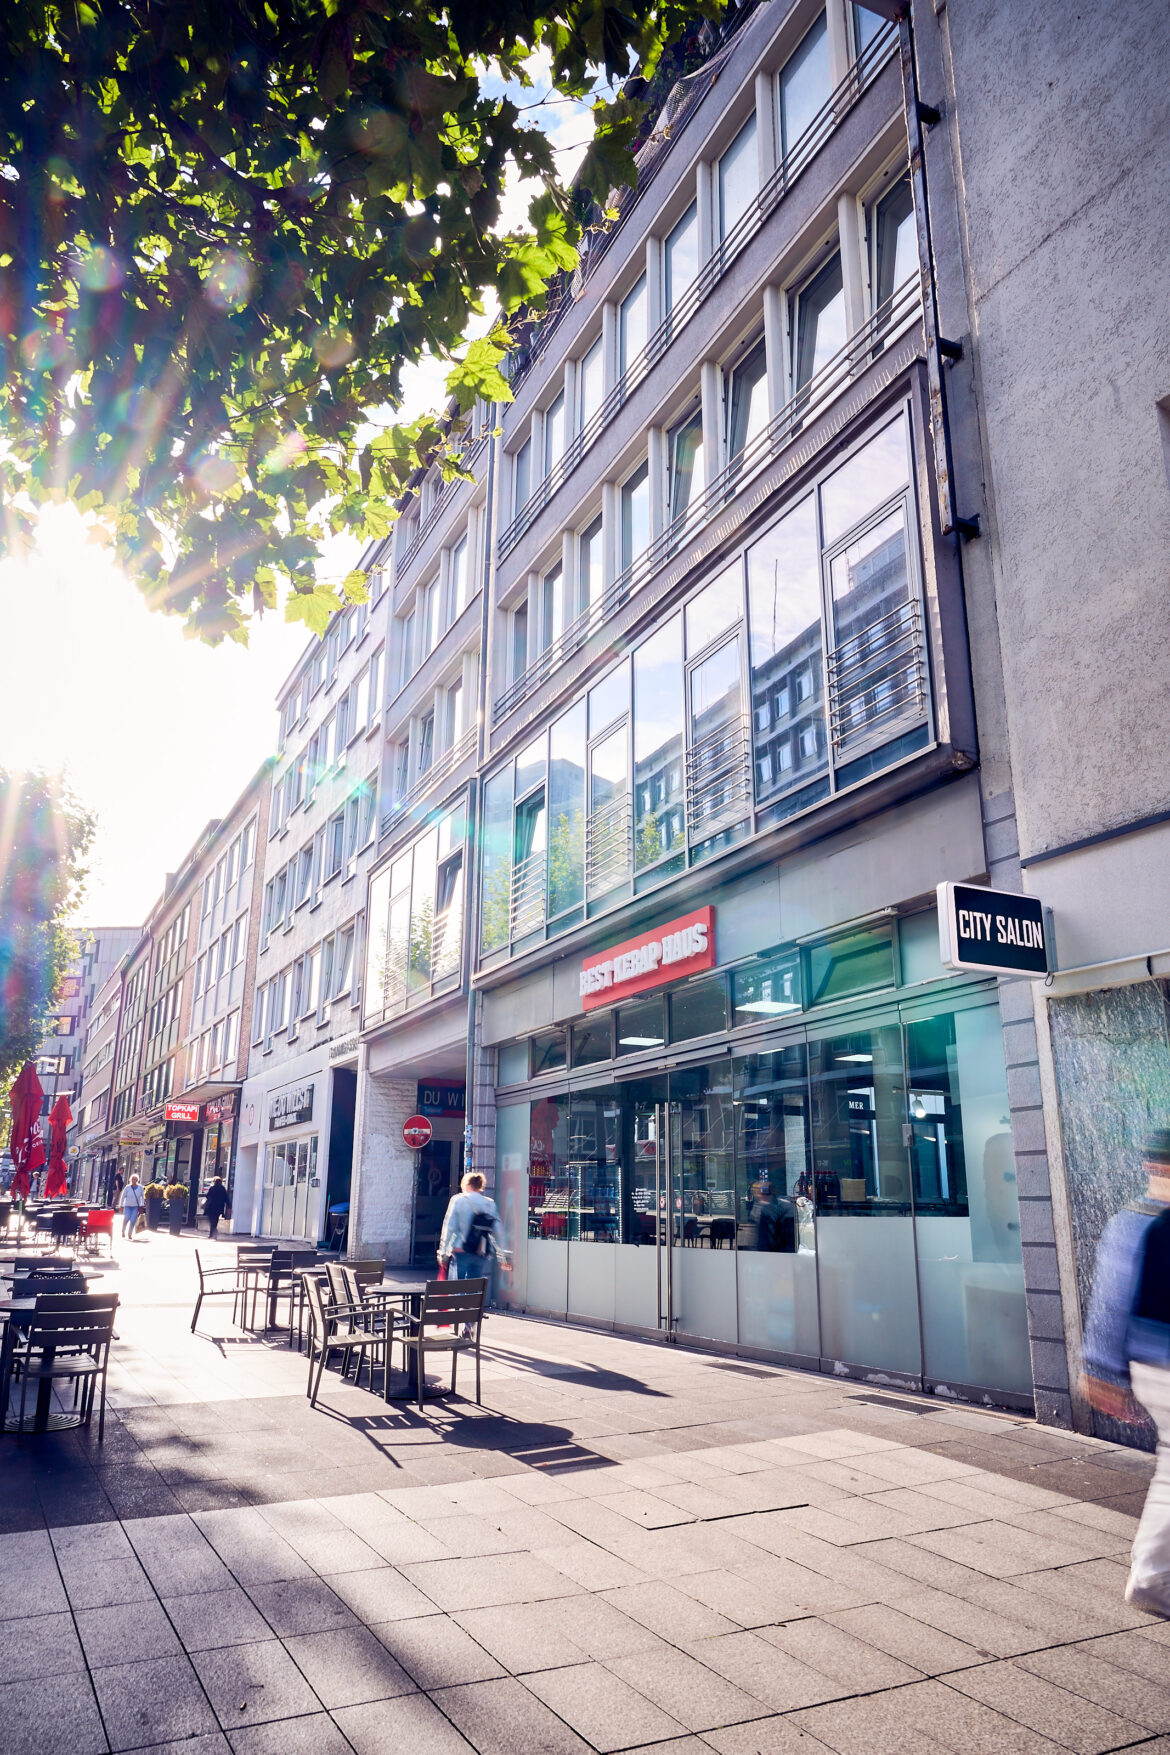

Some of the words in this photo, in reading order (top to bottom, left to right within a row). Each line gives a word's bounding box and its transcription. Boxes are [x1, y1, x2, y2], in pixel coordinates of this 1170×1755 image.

[958, 909, 992, 942] CITY
[995, 915, 1044, 949] SALON
[579, 960, 613, 997] BEST
[613, 941, 662, 983] KEBAP
[661, 923, 708, 966] HAUS
[423, 1090, 440, 1105] DU
[167, 1104, 198, 1112] TOPKAPI
[170, 1112, 192, 1120] GRILL
